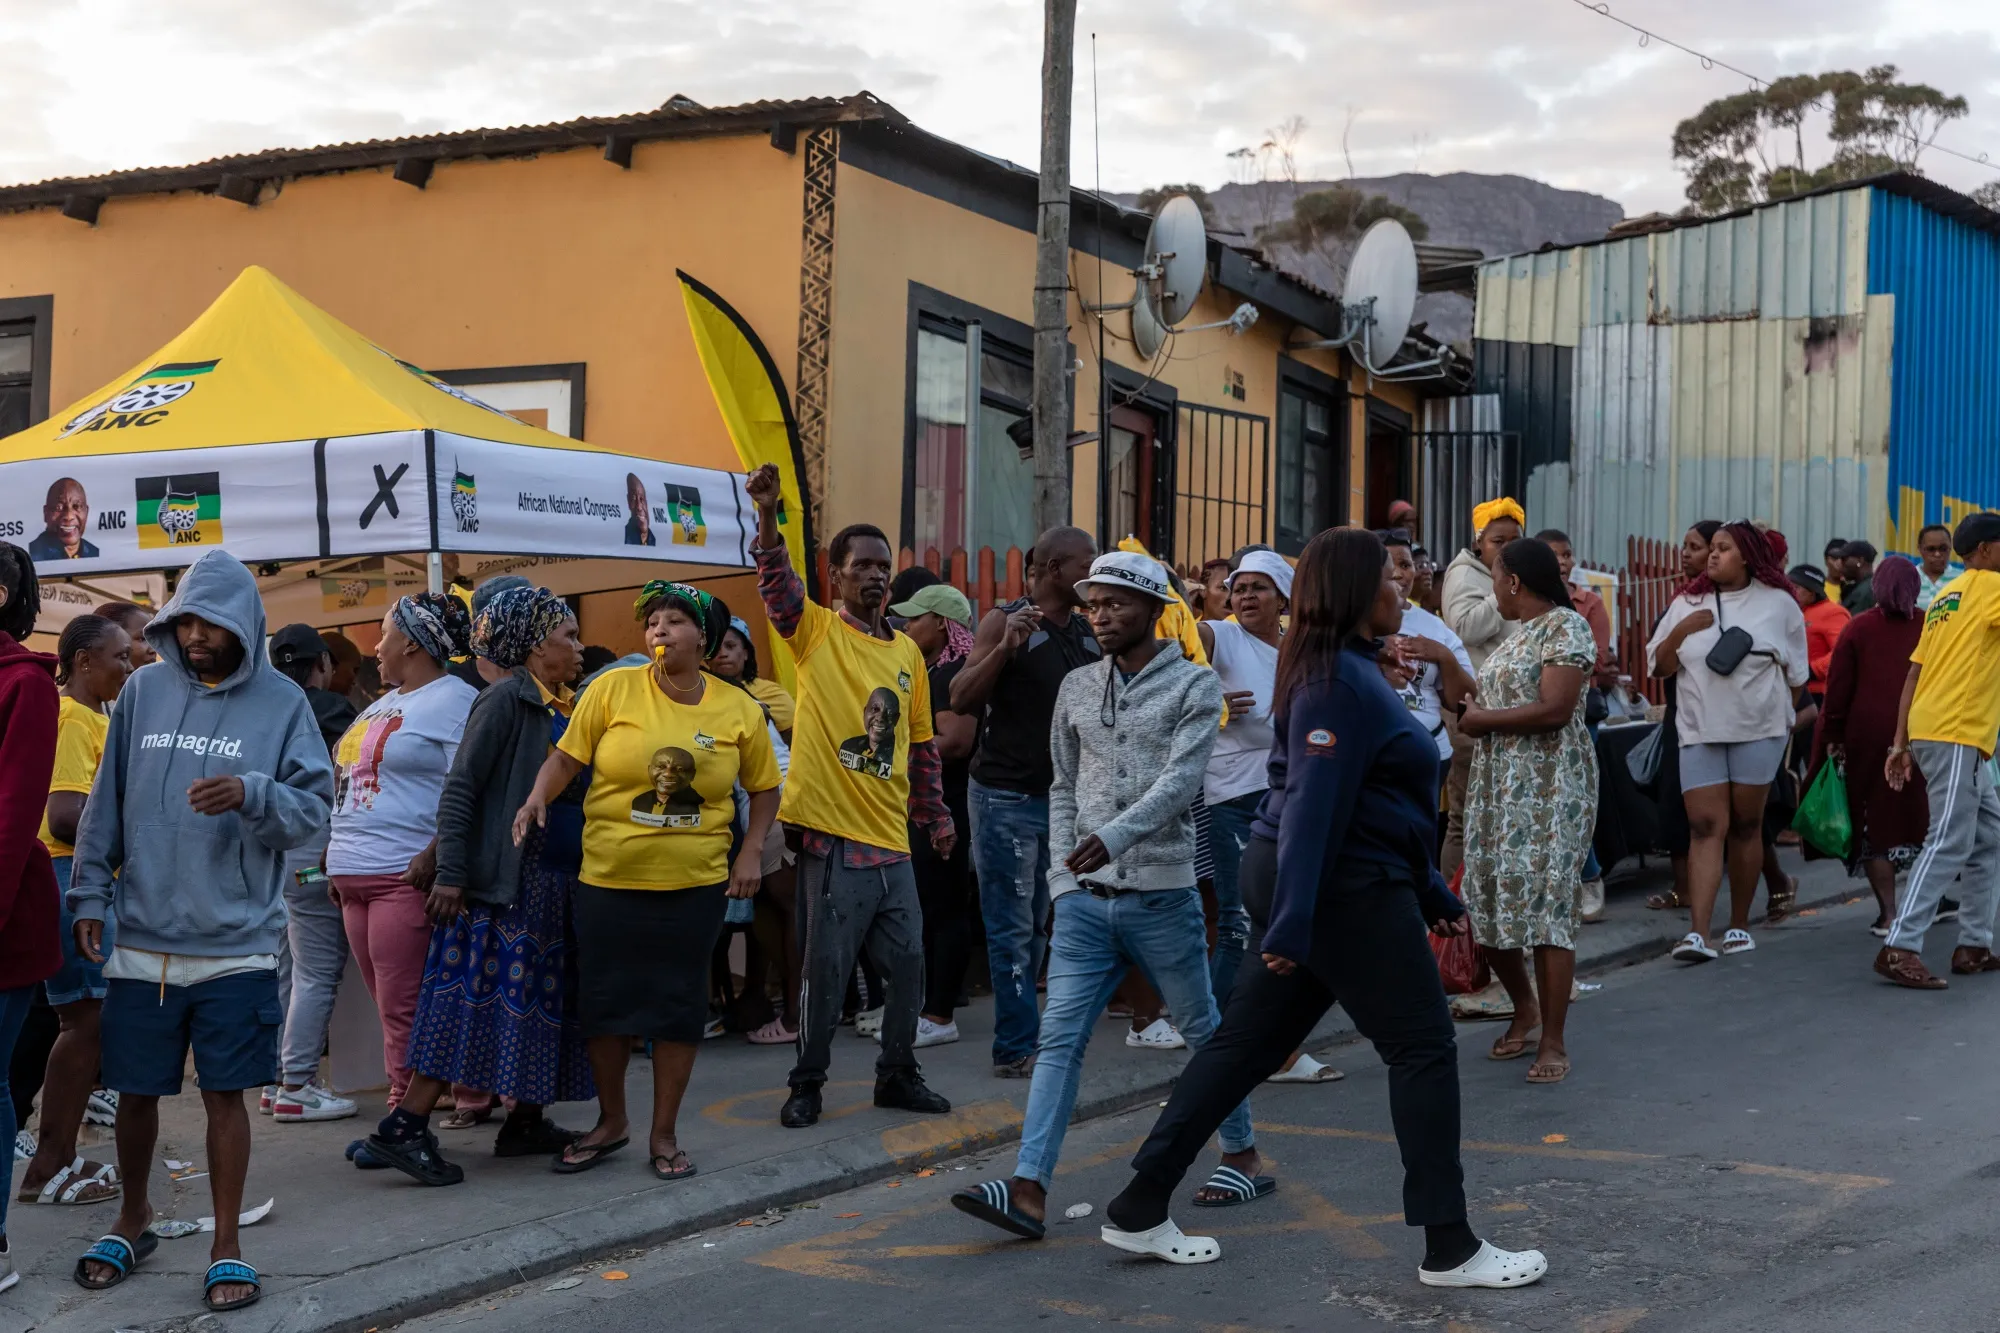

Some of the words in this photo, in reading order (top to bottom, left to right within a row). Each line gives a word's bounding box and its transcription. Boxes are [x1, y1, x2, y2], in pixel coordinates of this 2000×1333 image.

[75, 411, 169, 435] ANC
[518, 491, 549, 513] African
[549, 494, 583, 516] National
[584, 497, 622, 521] Congress
[98, 510, 126, 530] ANC
[652, 507, 668, 524] ANC
[461, 518, 480, 533] ANC
[175, 531, 201, 544] ANC
